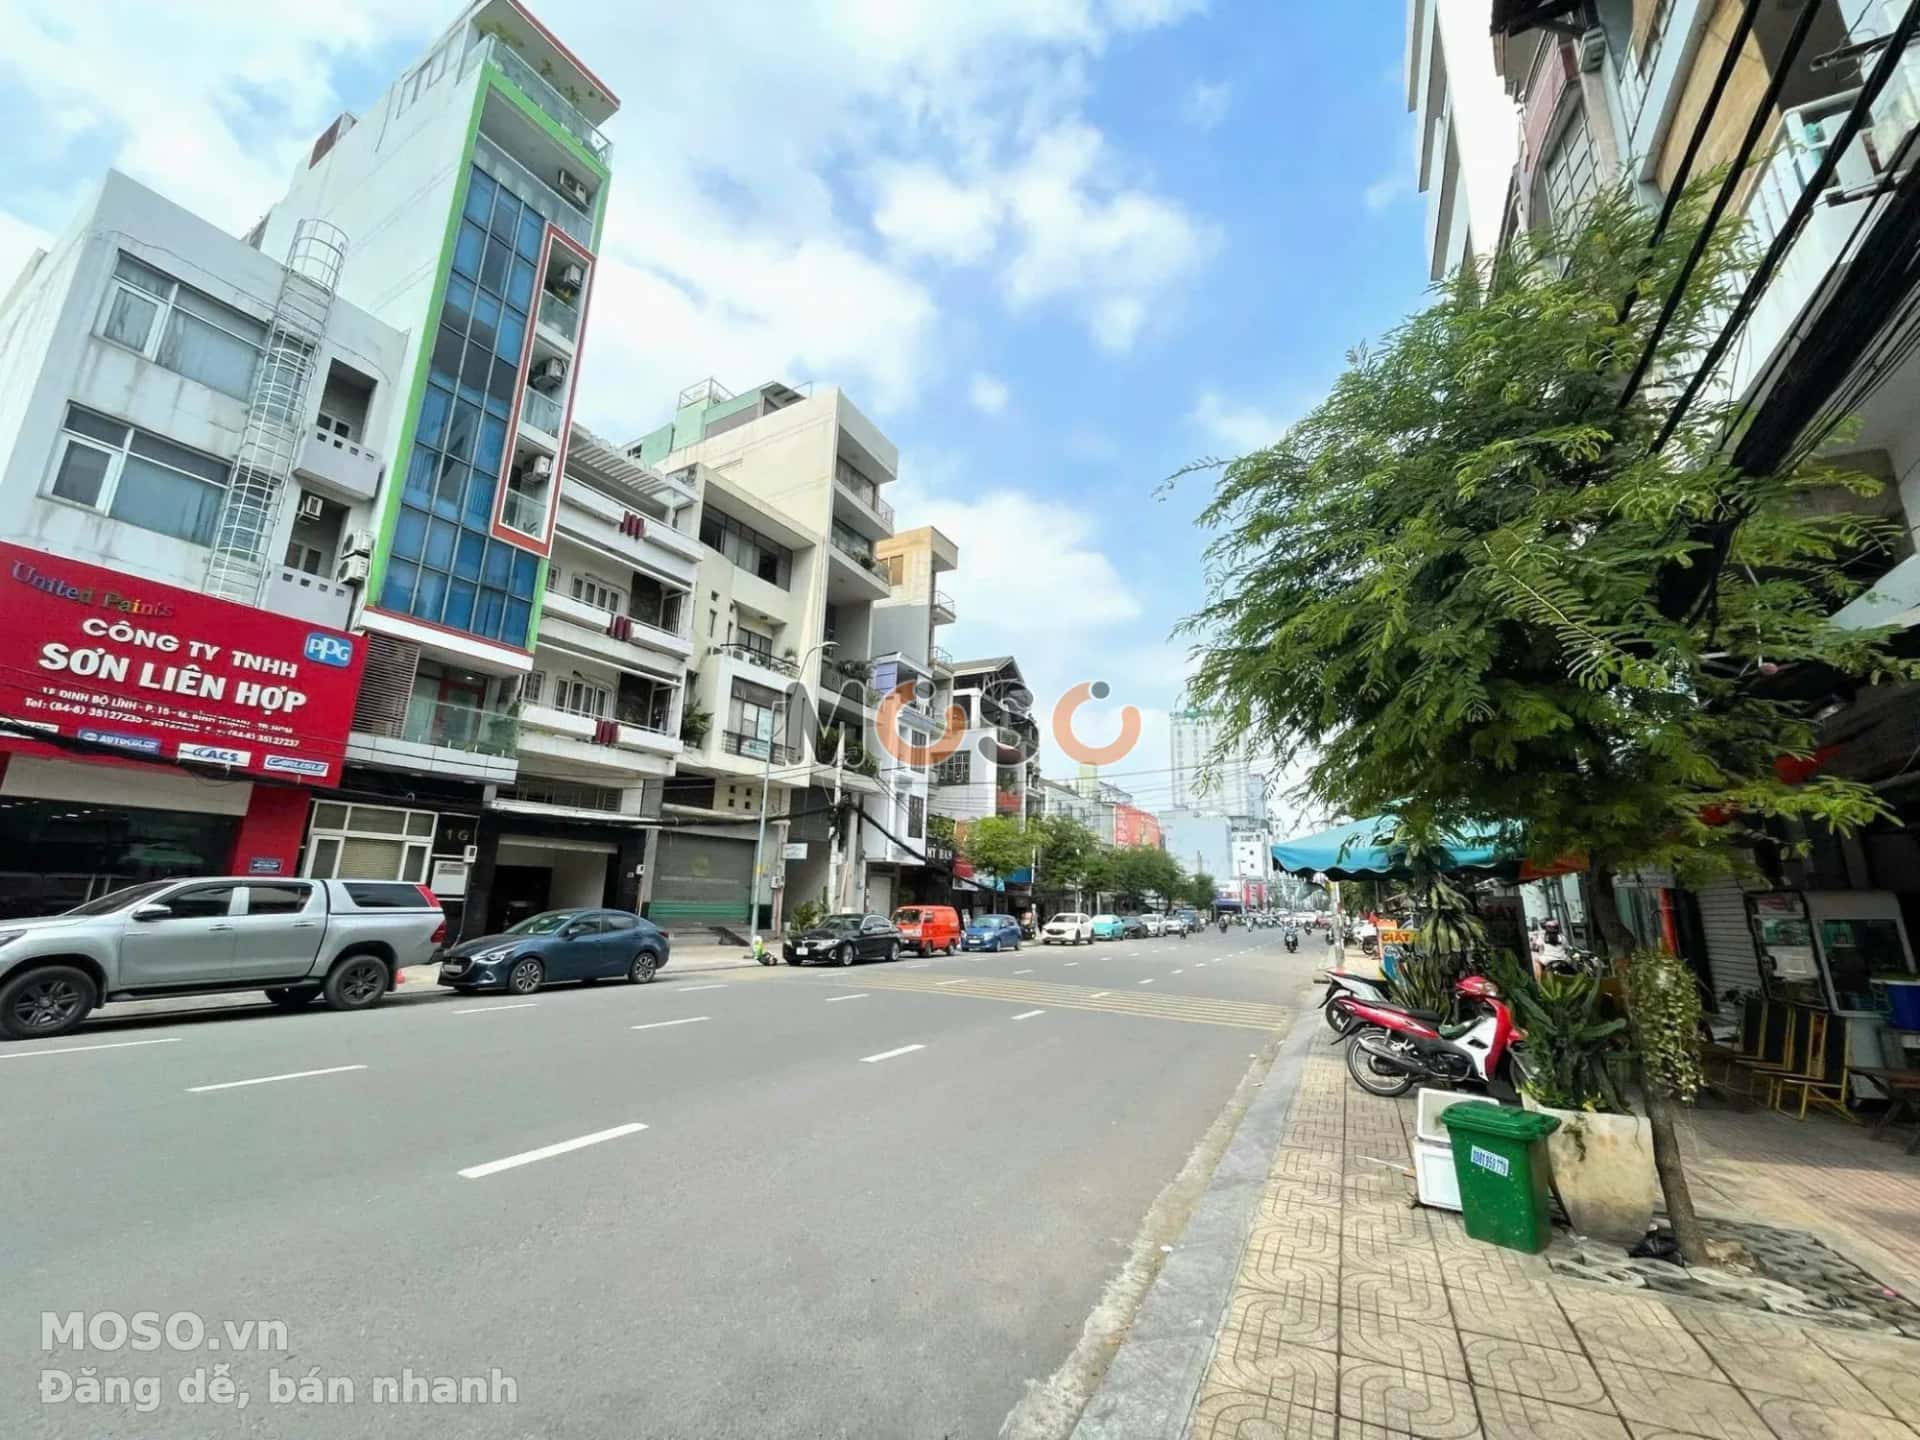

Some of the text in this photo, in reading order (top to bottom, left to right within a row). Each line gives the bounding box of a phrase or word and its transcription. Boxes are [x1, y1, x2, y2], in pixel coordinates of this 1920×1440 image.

[11, 560, 175, 617] United Paints
[82, 618, 298, 679] CÔNG TY TNHH
[308, 636, 350, 663] PPG
[38, 641, 307, 716] SƠN LIÊN HỢP
